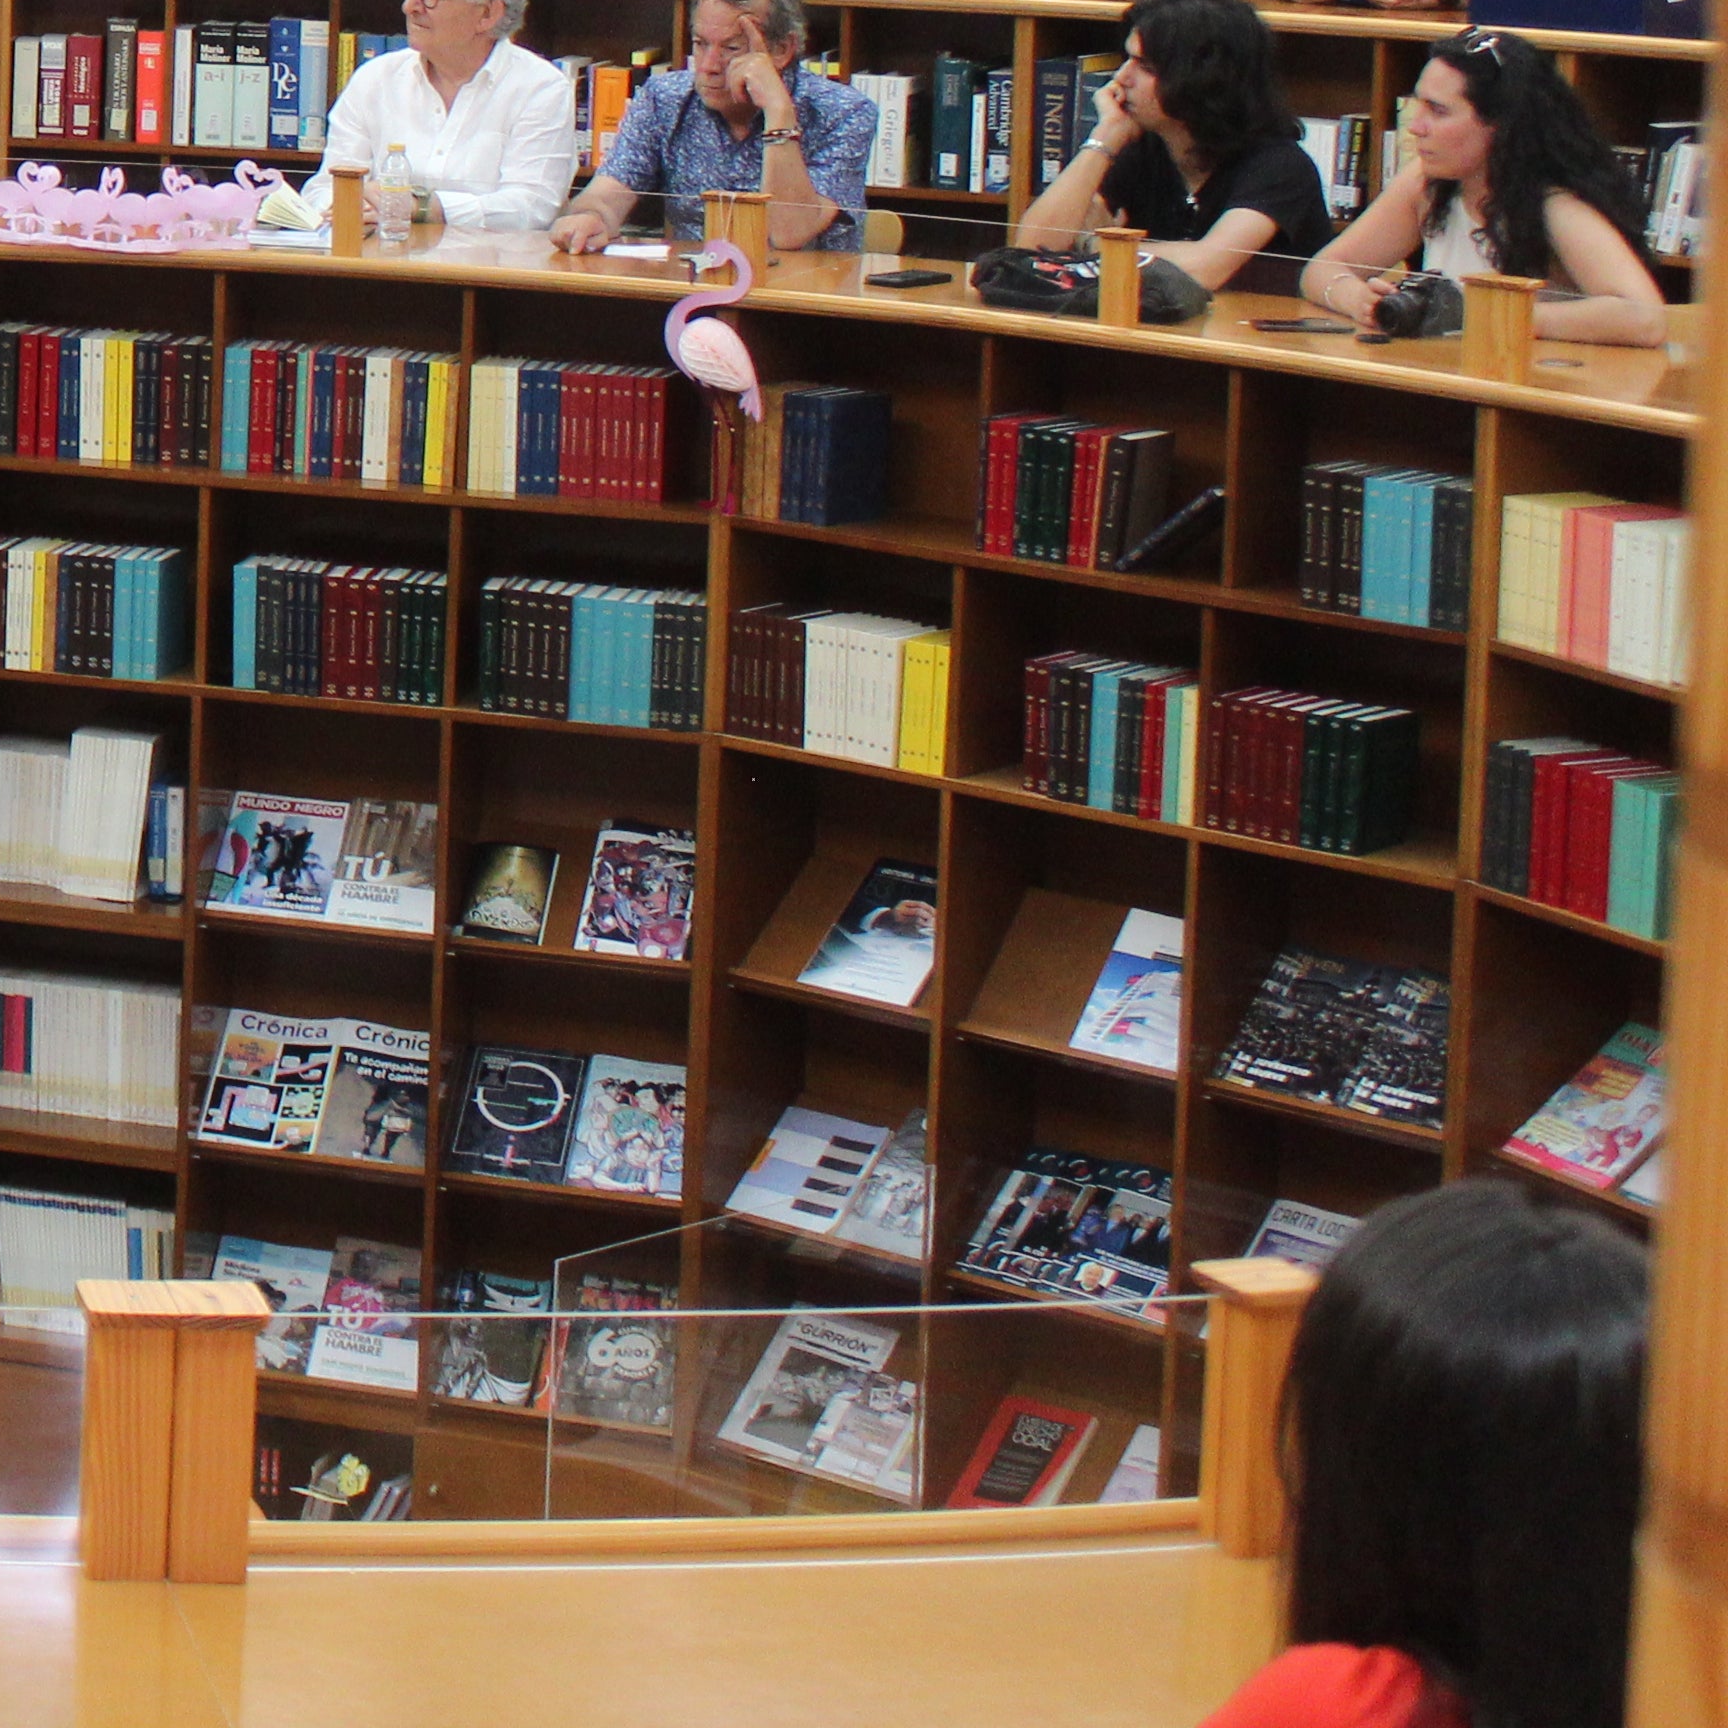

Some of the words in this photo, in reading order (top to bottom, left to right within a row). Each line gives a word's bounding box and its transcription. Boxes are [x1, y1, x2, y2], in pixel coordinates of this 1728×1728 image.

[200, 43, 224, 54] María
[236, 44, 260, 55] María
[200, 53, 231, 63] Moliner
[236, 54, 267, 64] Moliner
[204, 70, 225, 82] a-i
[239, 71, 261, 85] j-z
[238, 796, 292, 812] MUNDO
[294, 801, 344, 817] NEGRO
[343, 851, 393, 883] TÚ
[343, 883, 385, 895] CONTRA
[388, 886, 401, 896] EL
[340, 890, 401, 906] HAMBRE
[240, 1014, 329, 1040] Crónica
[355, 1025, 430, 1053] Crónic
[356, 1067, 369, 1077] en
[372, 1068, 385, 1078] el
[360, 1055, 429, 1075] acompañan
[1271, 1207, 1316, 1233] CARTA
[326, 1302, 364, 1330] TÚ
[327, 1329, 372, 1345] CONTRA
[325, 1337, 383, 1357] HAMBRE
[614, 1346, 651, 1358] AÑOS
